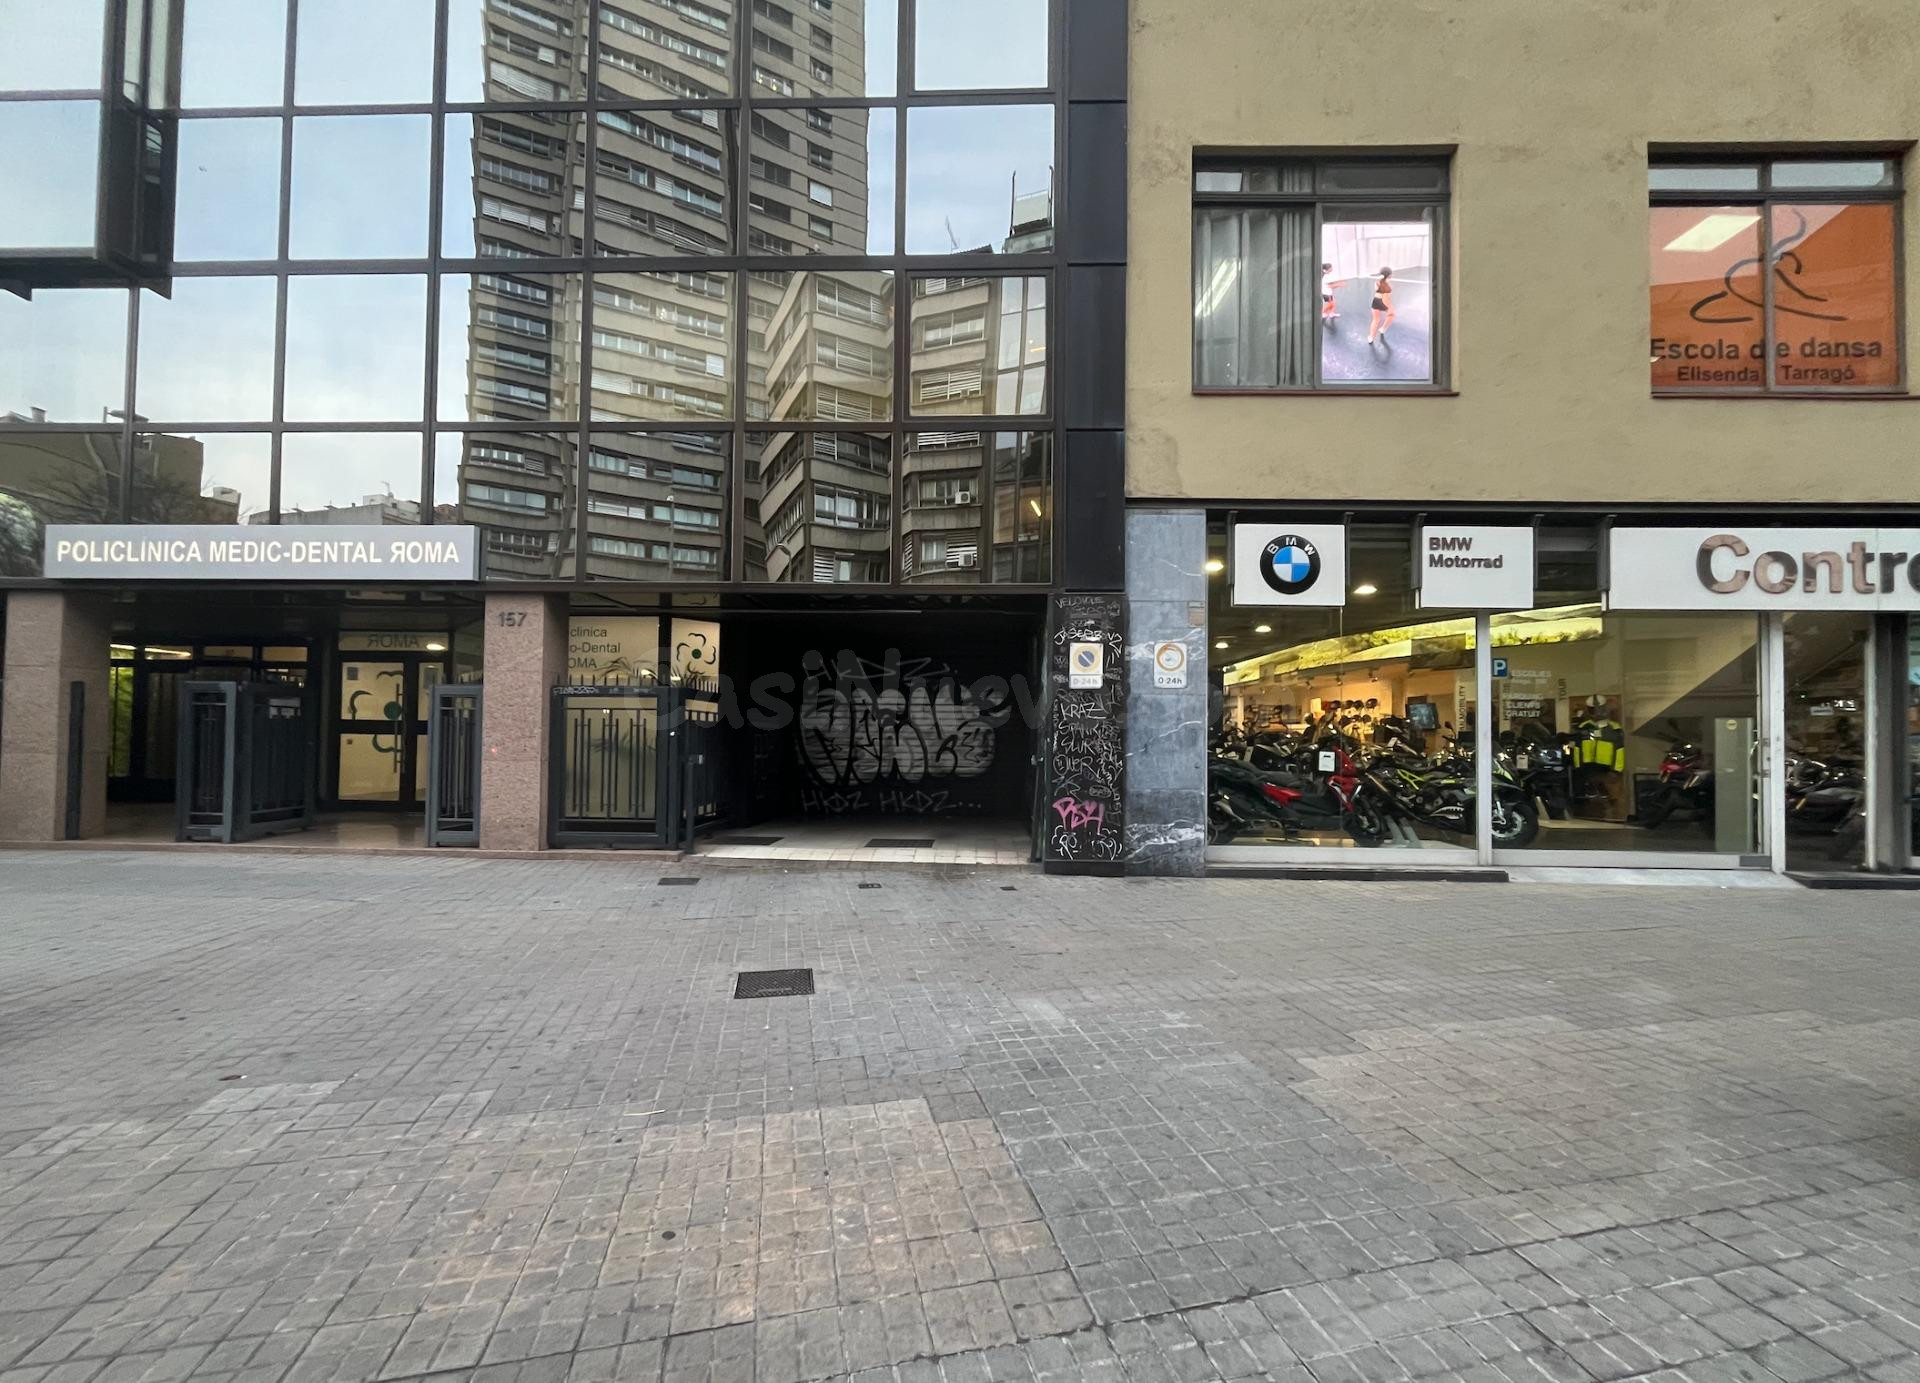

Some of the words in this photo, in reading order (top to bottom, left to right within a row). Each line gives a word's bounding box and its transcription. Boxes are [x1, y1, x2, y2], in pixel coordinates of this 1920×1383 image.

[1650, 338, 1740, 360] Escola
[1750, 339, 1791, 360] de
[1799, 337, 1883, 359] dansa
[1677, 365, 1760, 382] Elisenda
[1780, 364, 1856, 383] Tarragó
[209, 540, 382, 563] MEDIC-DENTAL
[1267, 537, 1315, 556] BMW
[1429, 537, 1473, 551] BMW
[1429, 554, 1504, 569] Motorrad
[498, 611, 527, 627] 157
[570, 641, 621, 653] o-Dental
[568, 657, 597, 669] OMA
[1493, 659, 1506, 676] P
